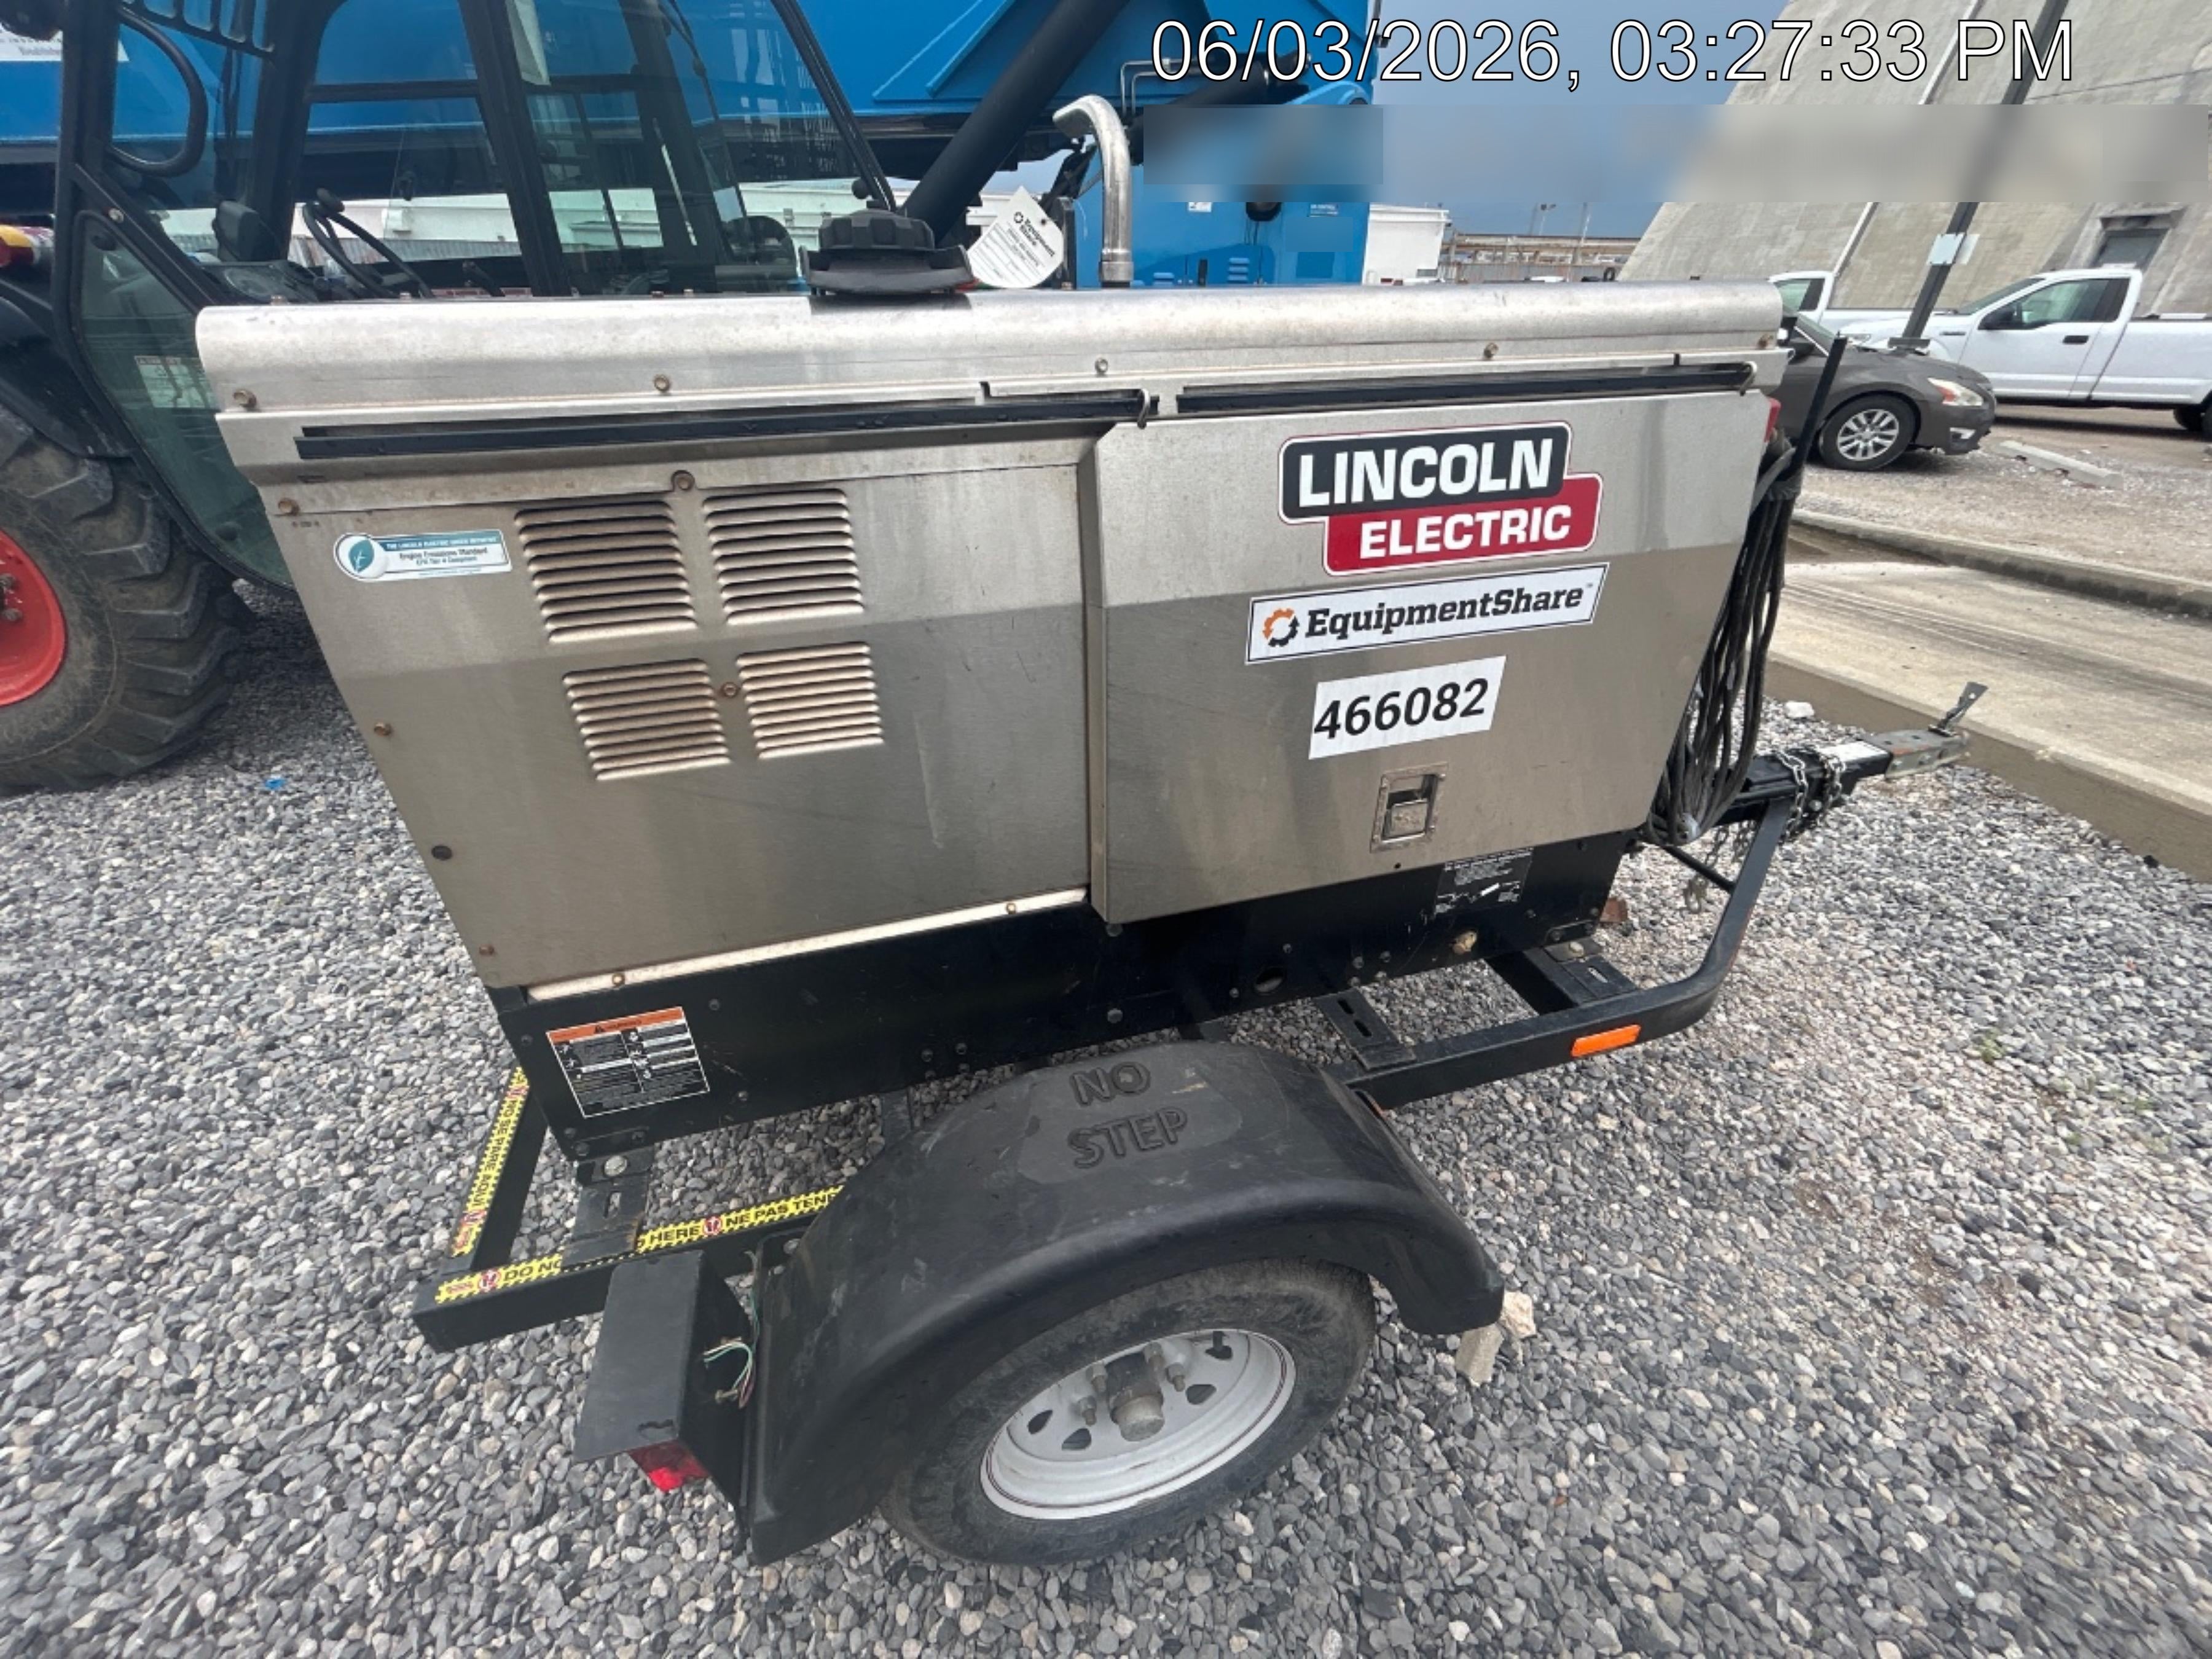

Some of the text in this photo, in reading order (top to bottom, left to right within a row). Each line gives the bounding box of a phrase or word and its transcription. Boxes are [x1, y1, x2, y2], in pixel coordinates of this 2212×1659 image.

[1298, 438, 1553, 508] LINCOLN
[1359, 504, 1572, 560] ELECTRIC
[1314, 677, 1489, 739] 466082
[1069, 1062, 1151, 1107] NO
[1067, 1107, 1188, 1169] STEP
[649, 1225, 699, 1243] HERE
[725, 1213, 751, 1227] NE
[755, 1204, 789, 1219] PAS
[504, 1266, 533, 1282] DO
